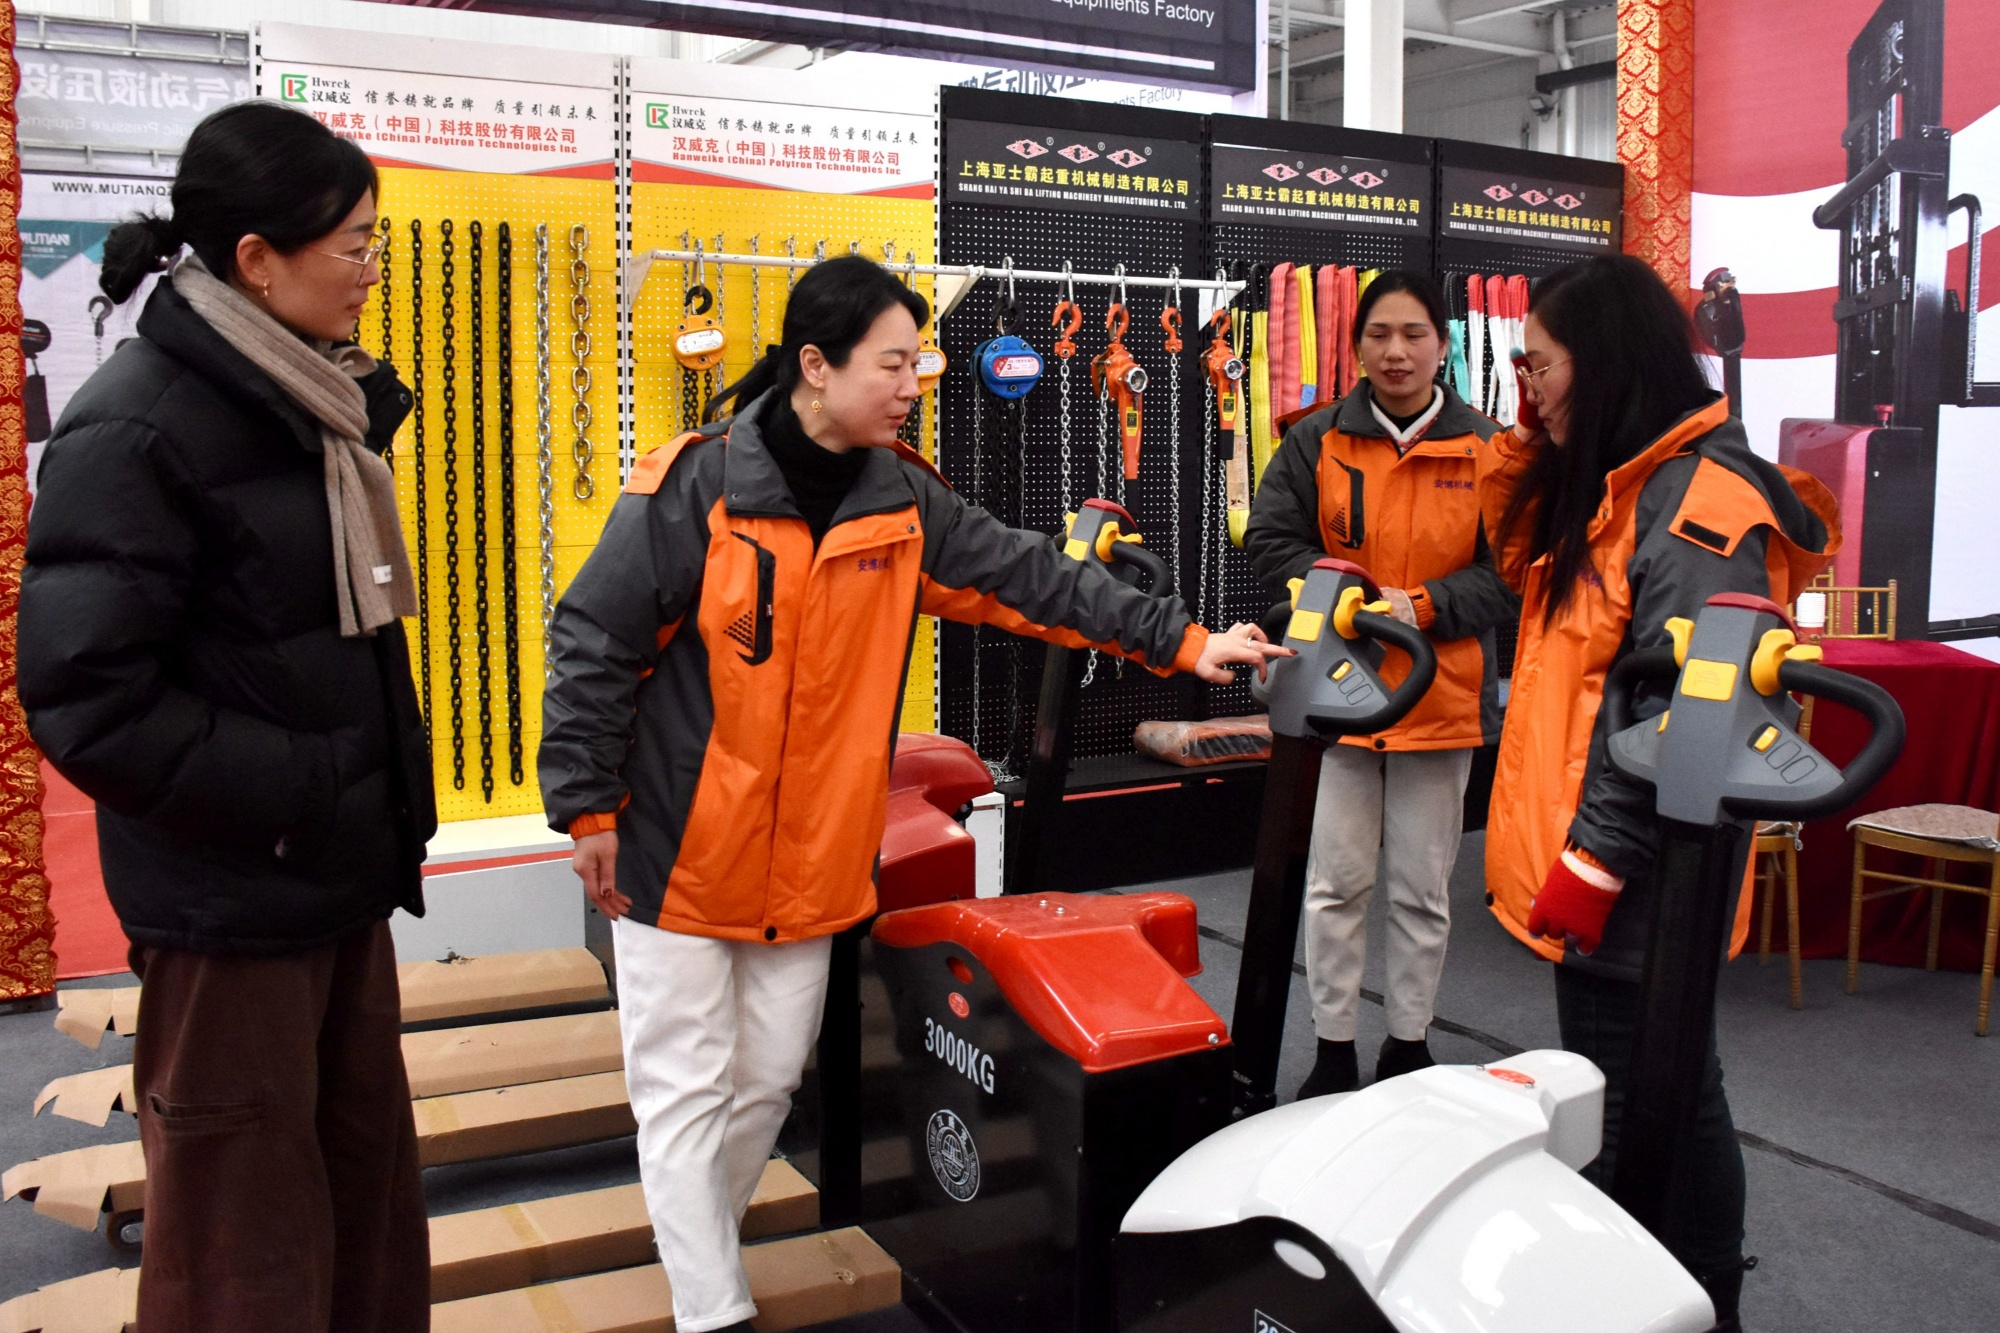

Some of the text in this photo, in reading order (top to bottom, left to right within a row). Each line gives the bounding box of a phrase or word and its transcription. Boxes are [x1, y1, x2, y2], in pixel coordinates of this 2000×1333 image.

[1155, 0, 1215, 28] Factory
[312, 90, 351, 105] 汉威克
[672, 117, 706, 131] 汉威克
[377, 132, 421, 143] (China)
[425, 136, 475, 147] Polytron
[479, 139, 557, 152] Technologies
[560, 145, 578, 153] Inc
[672, 152, 901, 175] Hanweike (China) Polytron Technologies Inc
[958, 182, 1188, 209] SHANG HAI YA SHI BA LIFTING MACHINERY MANUFACTURING CO., LTD.
[925, 1017, 995, 1095] 3000KG
